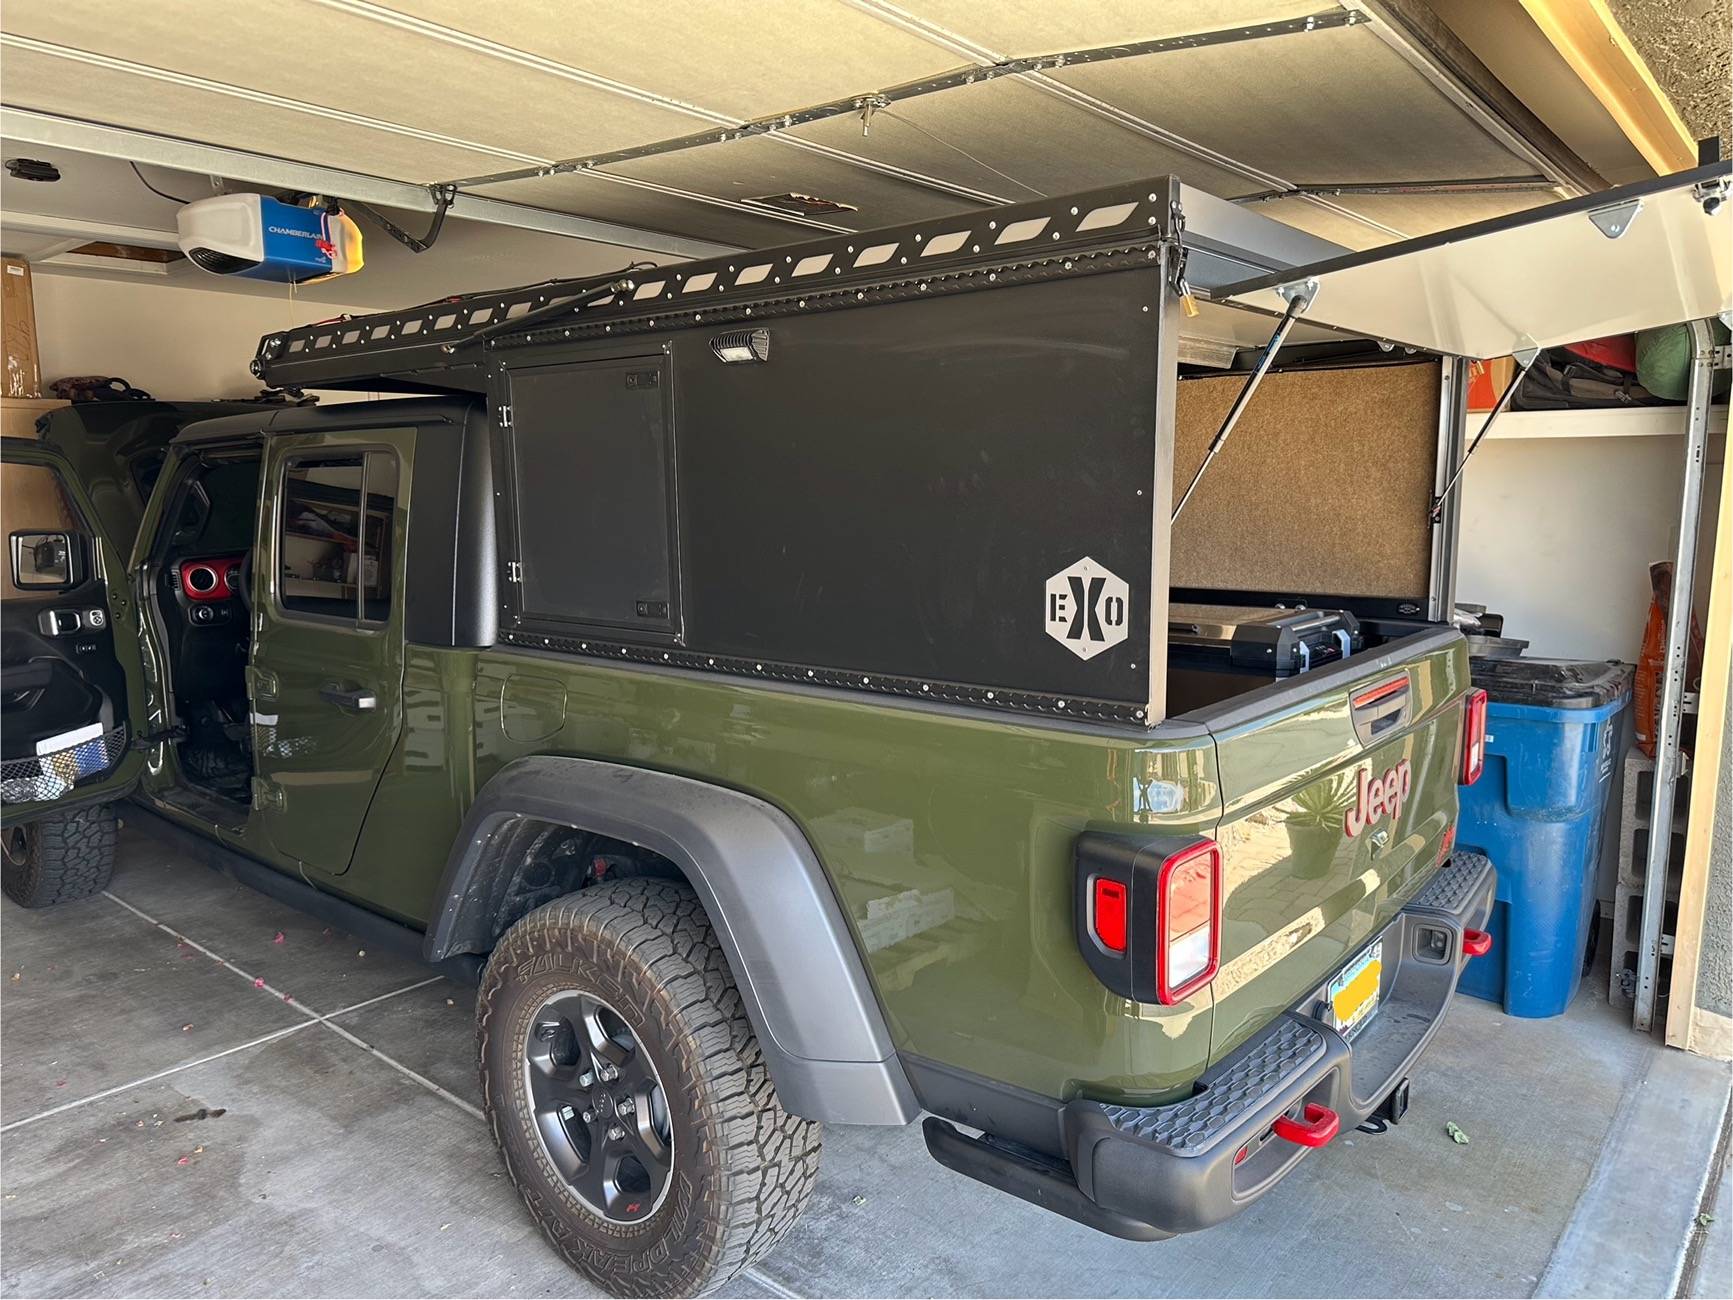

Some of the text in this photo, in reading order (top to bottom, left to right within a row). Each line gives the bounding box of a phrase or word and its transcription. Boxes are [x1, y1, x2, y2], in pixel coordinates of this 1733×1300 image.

[268, 225, 323, 240] CHAMBERLAIN
[1050, 575, 1124, 642] EXO
[1342, 758, 1412, 839] Jeep
